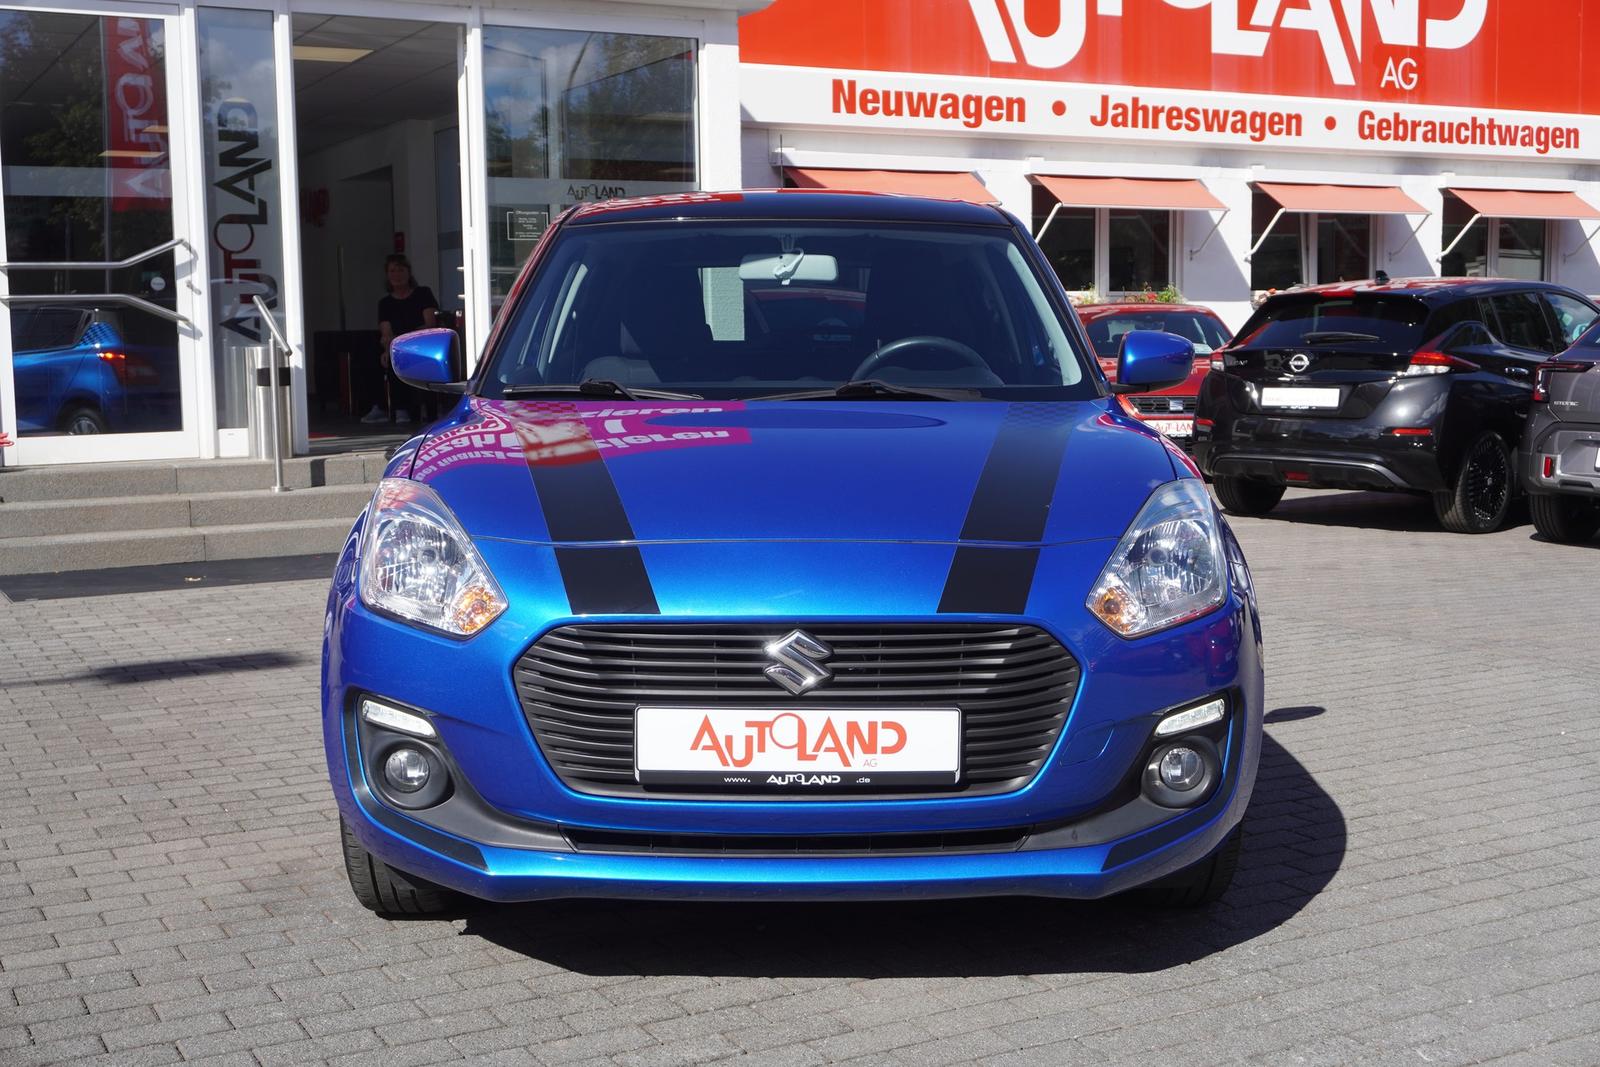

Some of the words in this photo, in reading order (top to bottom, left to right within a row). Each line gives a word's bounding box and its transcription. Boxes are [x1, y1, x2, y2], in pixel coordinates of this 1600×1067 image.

[1380, 56, 1418, 90] AG
[832, 79, 1026, 128] Neuwagen
[1090, 95, 1302, 142] Jahreswagen
[1358, 110, 1580, 154] Gebrauchtwagen
[213, 97, 278, 343] AUTOLAND
[690, 713, 907, 767] AUTOLAND
[766, 773, 841, 785] AUTOLAND
[863, 758, 878, 767] AG
